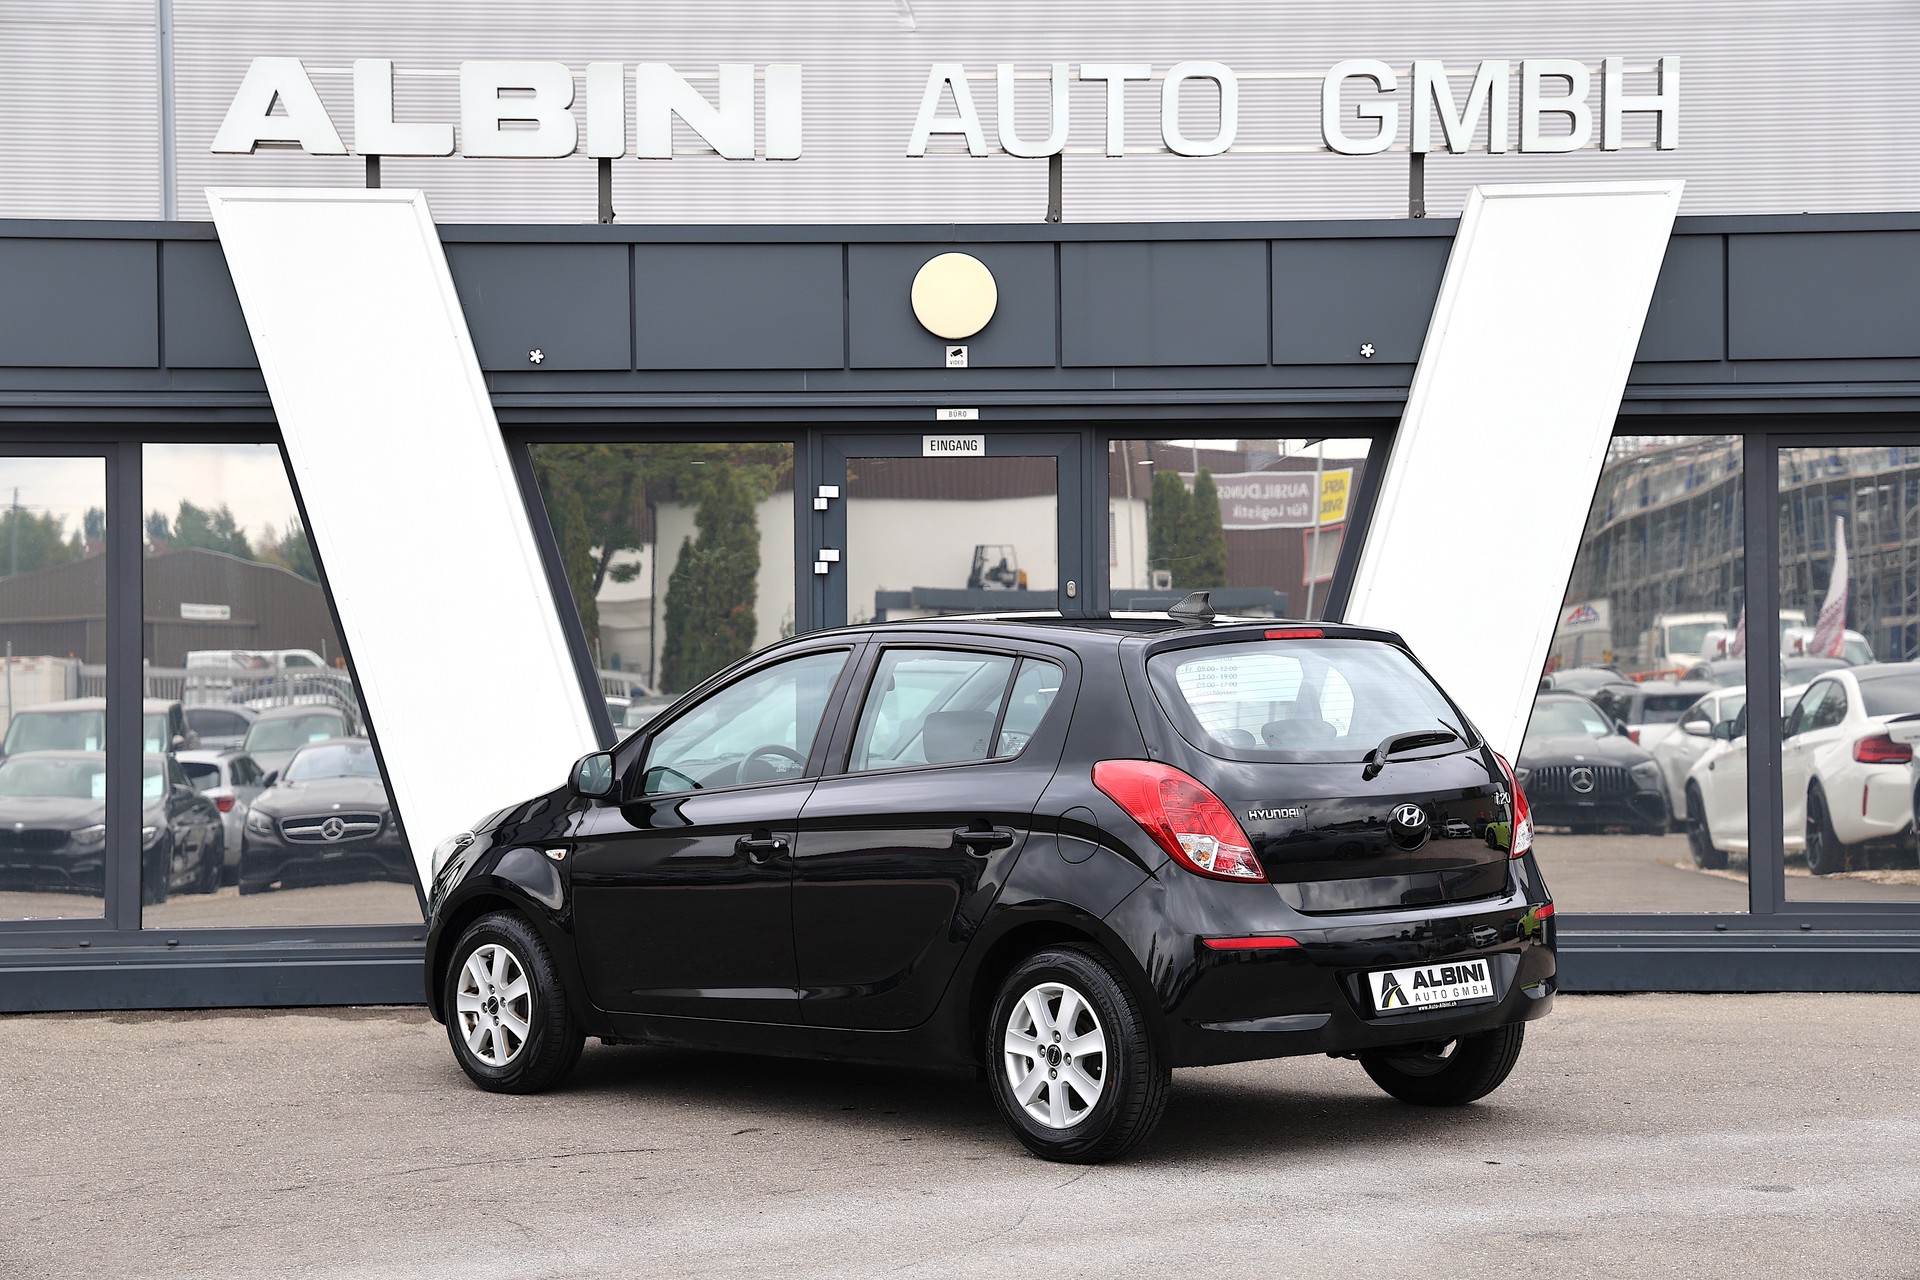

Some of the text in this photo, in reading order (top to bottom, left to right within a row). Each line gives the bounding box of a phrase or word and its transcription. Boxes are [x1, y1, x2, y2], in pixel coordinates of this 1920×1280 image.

[210, 56, 1681, 161] ALBINI AUTO GMBH
[948, 410, 968, 418] BÜRO
[930, 440, 978, 451] EINGANG
[1248, 808, 1300, 821] HYUNDAI
[1413, 963, 1485, 990] ALBINI
[1415, 985, 1488, 1002] AUTO GMBH
